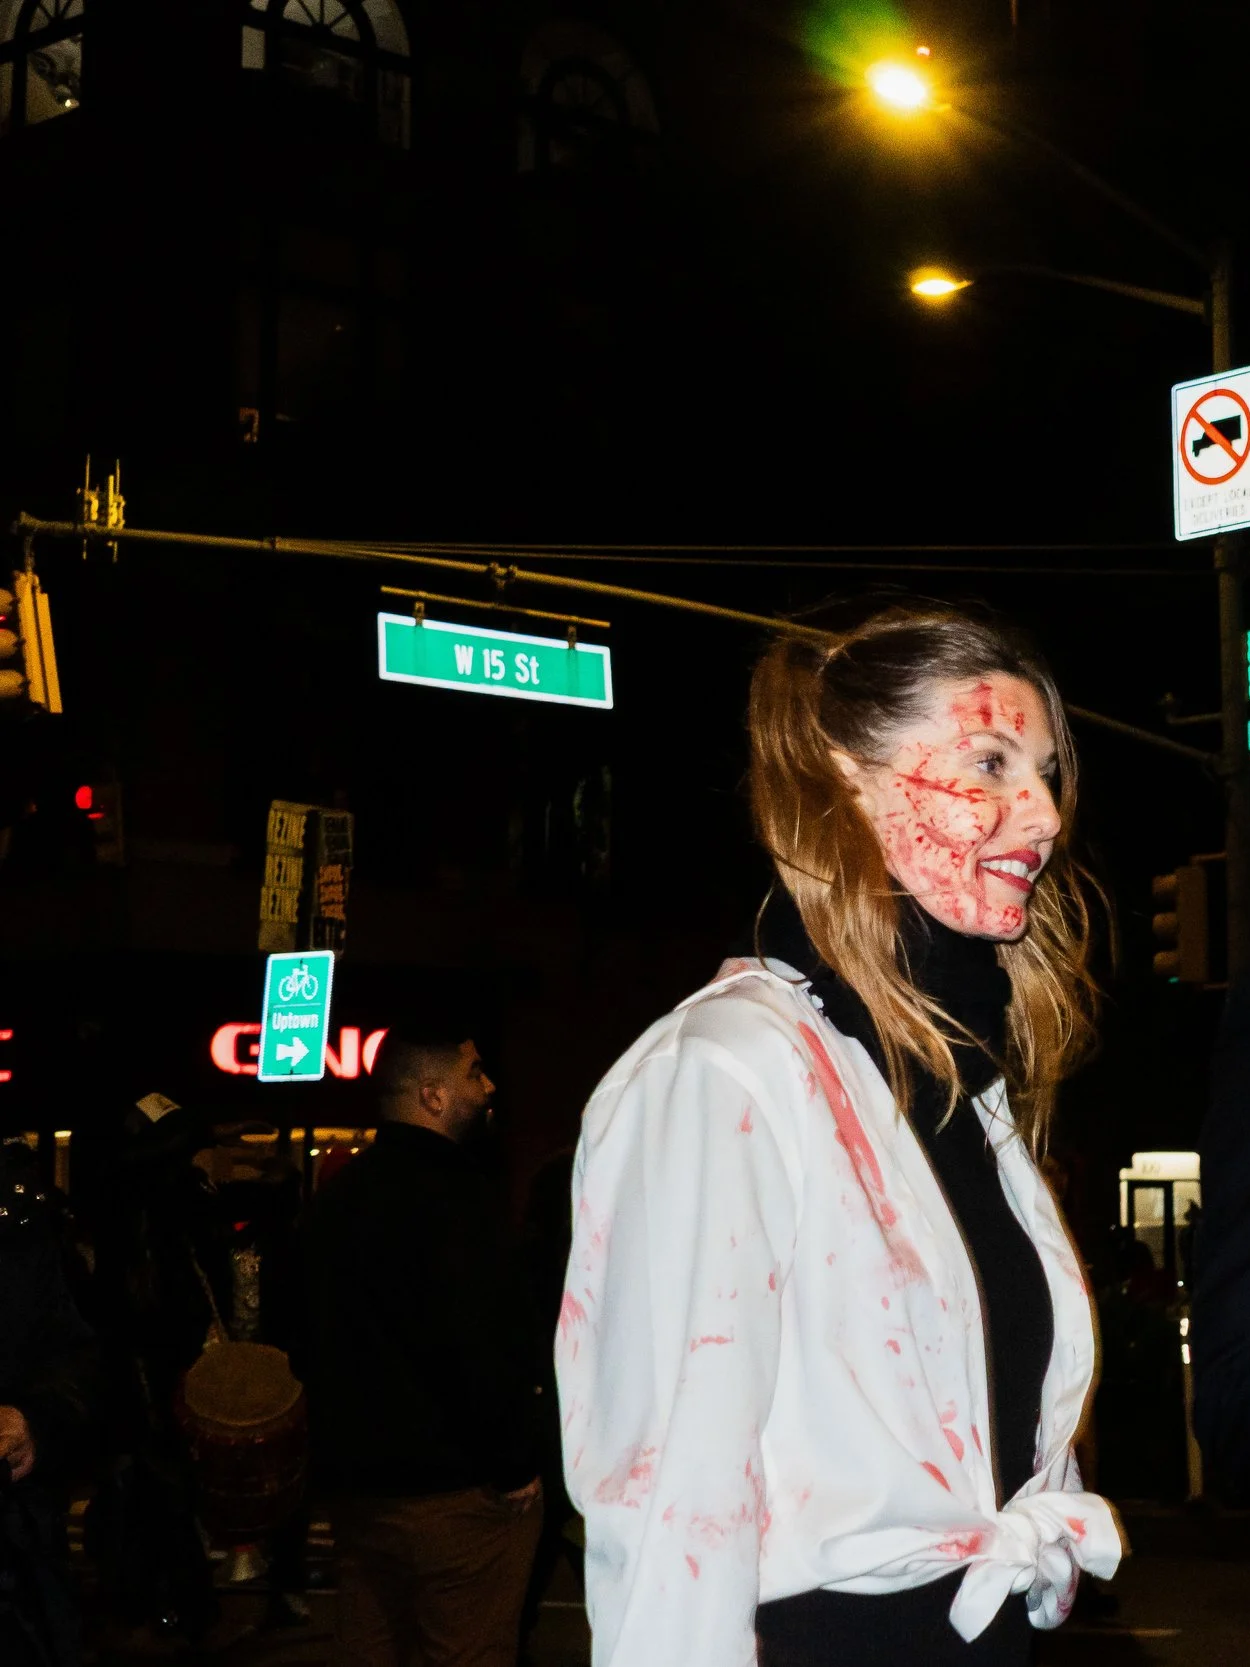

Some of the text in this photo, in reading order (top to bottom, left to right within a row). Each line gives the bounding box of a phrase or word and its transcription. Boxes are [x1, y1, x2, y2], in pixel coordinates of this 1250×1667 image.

[454, 643, 540, 685] W 15 St
[272, 1012, 319, 1033] Uptown
